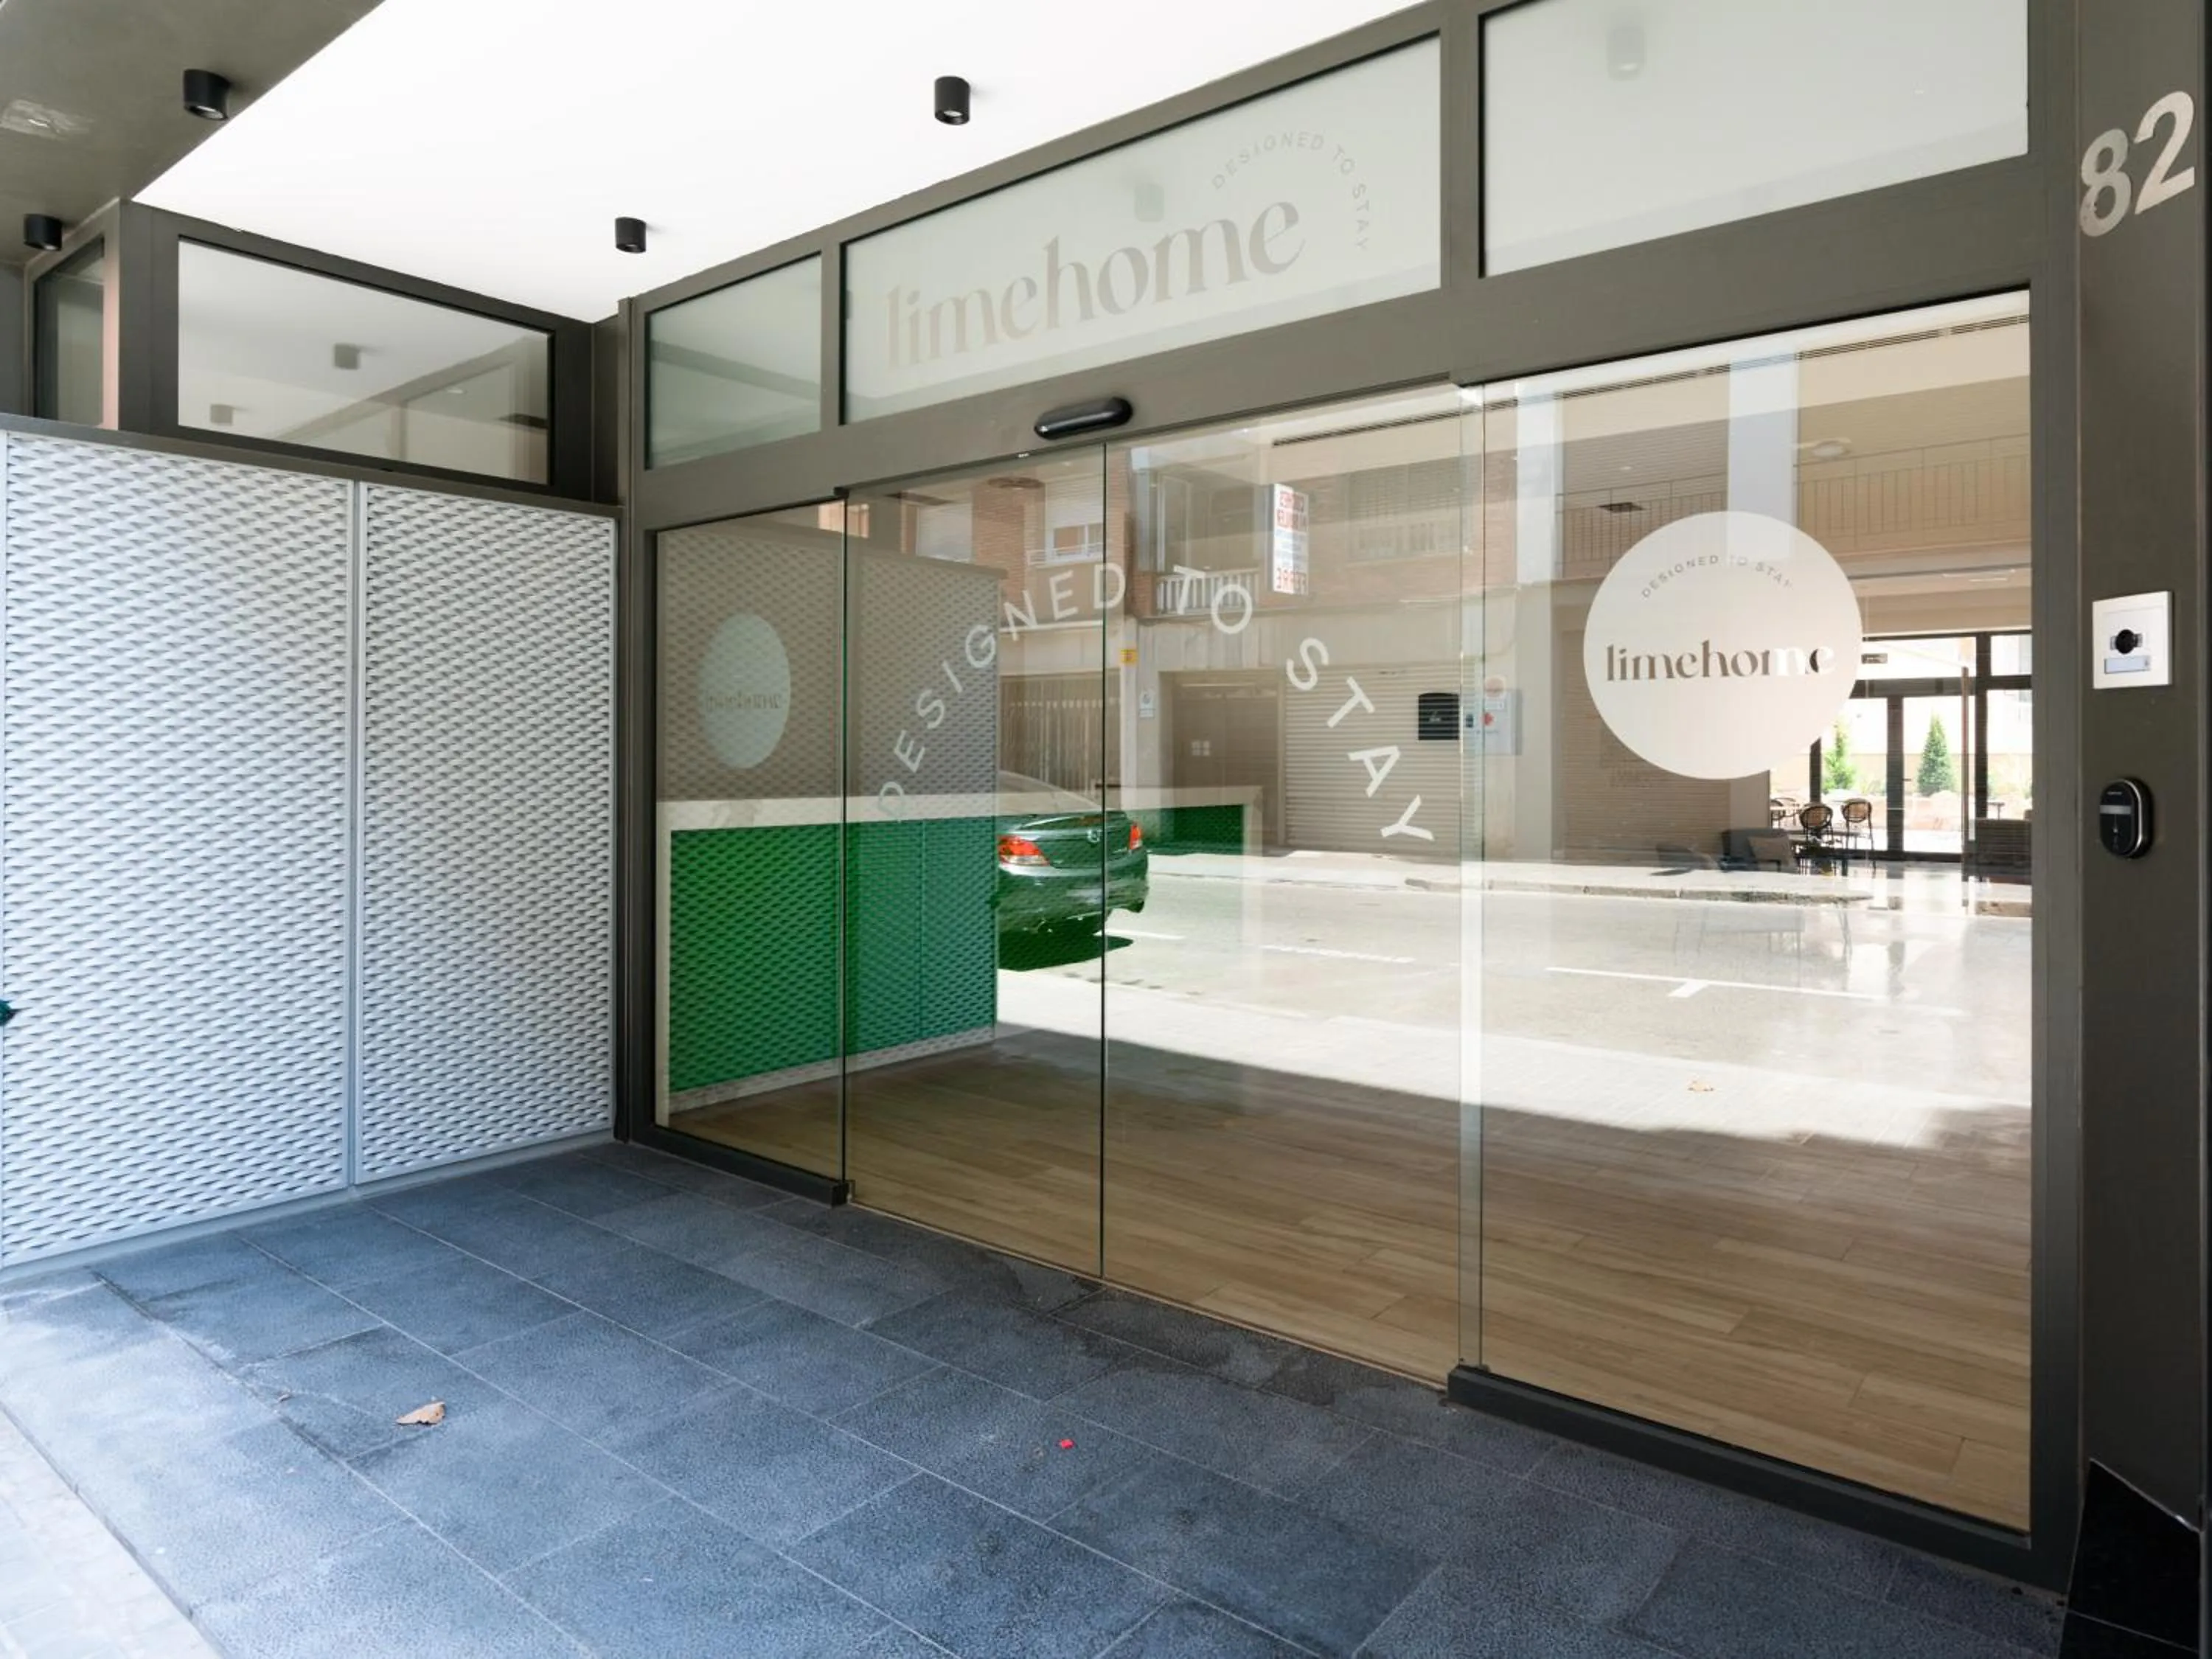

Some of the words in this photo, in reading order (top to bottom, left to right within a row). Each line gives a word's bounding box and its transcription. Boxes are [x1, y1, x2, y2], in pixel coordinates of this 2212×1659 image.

[1211, 131, 1324, 190] DESIGNED
[1331, 146, 1356, 175] TO
[1351, 181, 1371, 251] STAY
[2080, 91, 2195, 237] 82
[886, 200, 1307, 369] limehome
[877, 562, 1126, 823] DESIGNED
[1172, 565, 1253, 634] TO
[1286, 637, 1436, 842] STAY
[1605, 639, 1835, 682] limehome
